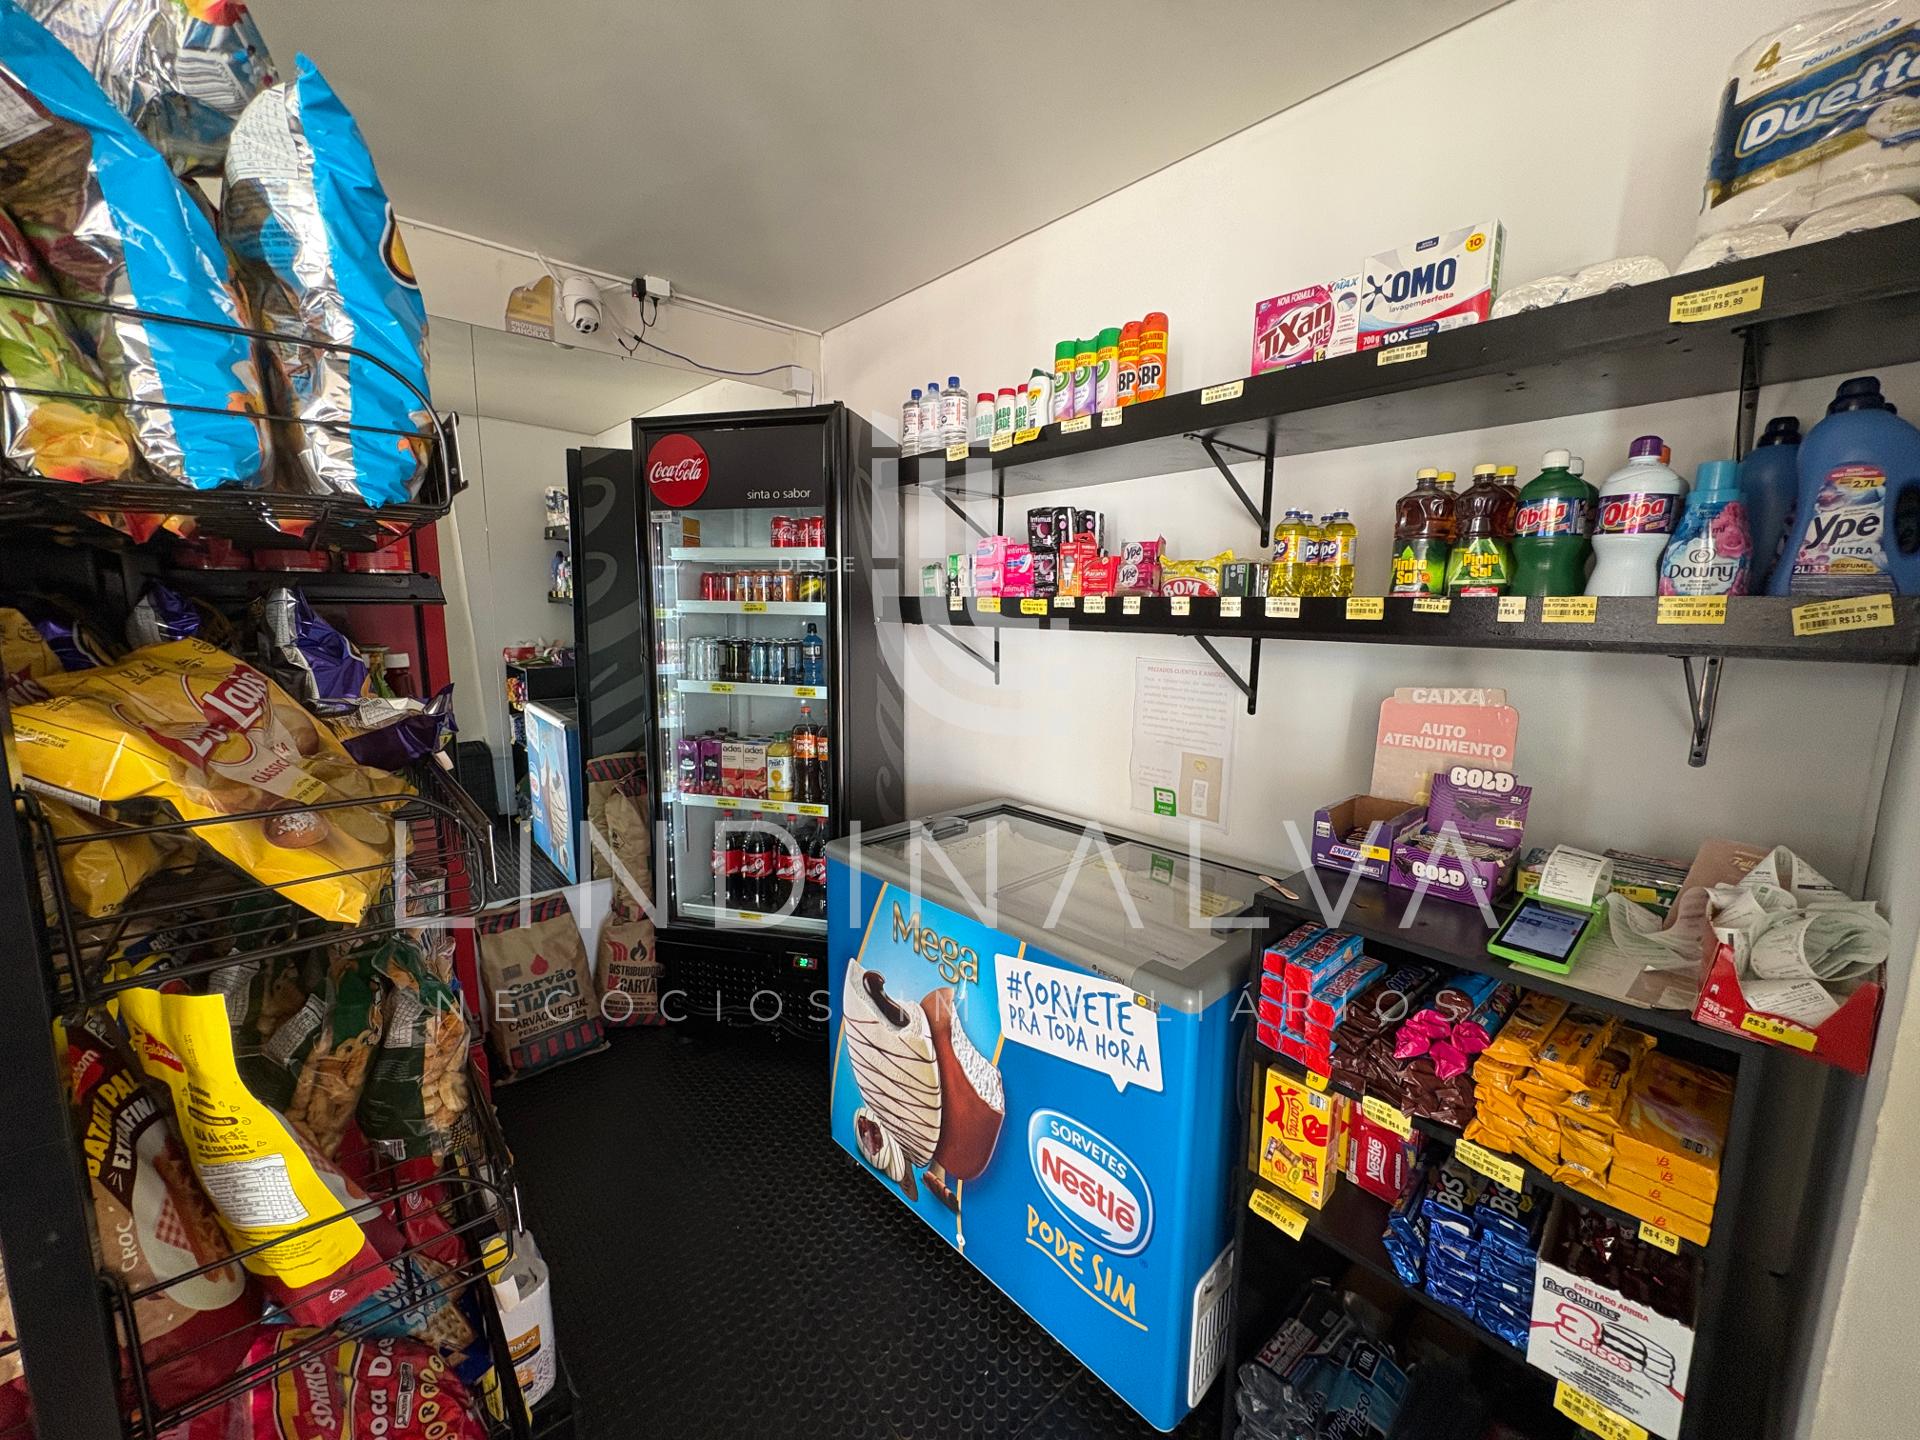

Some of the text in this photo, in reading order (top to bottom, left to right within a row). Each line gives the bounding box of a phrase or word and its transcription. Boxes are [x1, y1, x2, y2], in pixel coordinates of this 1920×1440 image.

[1753, 41, 1782, 73] 4
[1390, 257, 1456, 303] OMO
[1118, 371, 1136, 393] BP
[746, 491, 770, 500] sinta
[783, 488, 811, 499] sabor
[1463, 552, 1500, 567] Pinho
[1831, 546, 1873, 555] ULTRA
[1471, 565, 1493, 578] Sol
[1669, 564, 1735, 582] Downy
[1412, 688, 1488, 706] CAIXA
[1420, 722, 1467, 738] AUTO
[1383, 732, 1507, 758] ATENDIMENTO
[1450, 766, 1515, 793] BOLD
[1331, 846, 1363, 859] SNICKE
[1411, 860, 1466, 887] BOLD
[890, 901, 979, 984] Mega
[508, 968, 577, 997] Carvão
[1006, 970, 1135, 1038] #SORVETE
[1009, 1003, 1150, 1073] PRA TODA HORA
[1049, 1119, 1128, 1180] SORVETES
[1041, 1146, 1136, 1234] Nestlé
[116, 1217, 139, 1273] CROC
[1642, 1226, 1675, 1247] R$4,99
[1026, 1204, 1137, 1317] PODE SIM
[1574, 1282, 1650, 1323] ESTE LADO ARRIBA
[1580, 1337, 1633, 1373] PISOS
